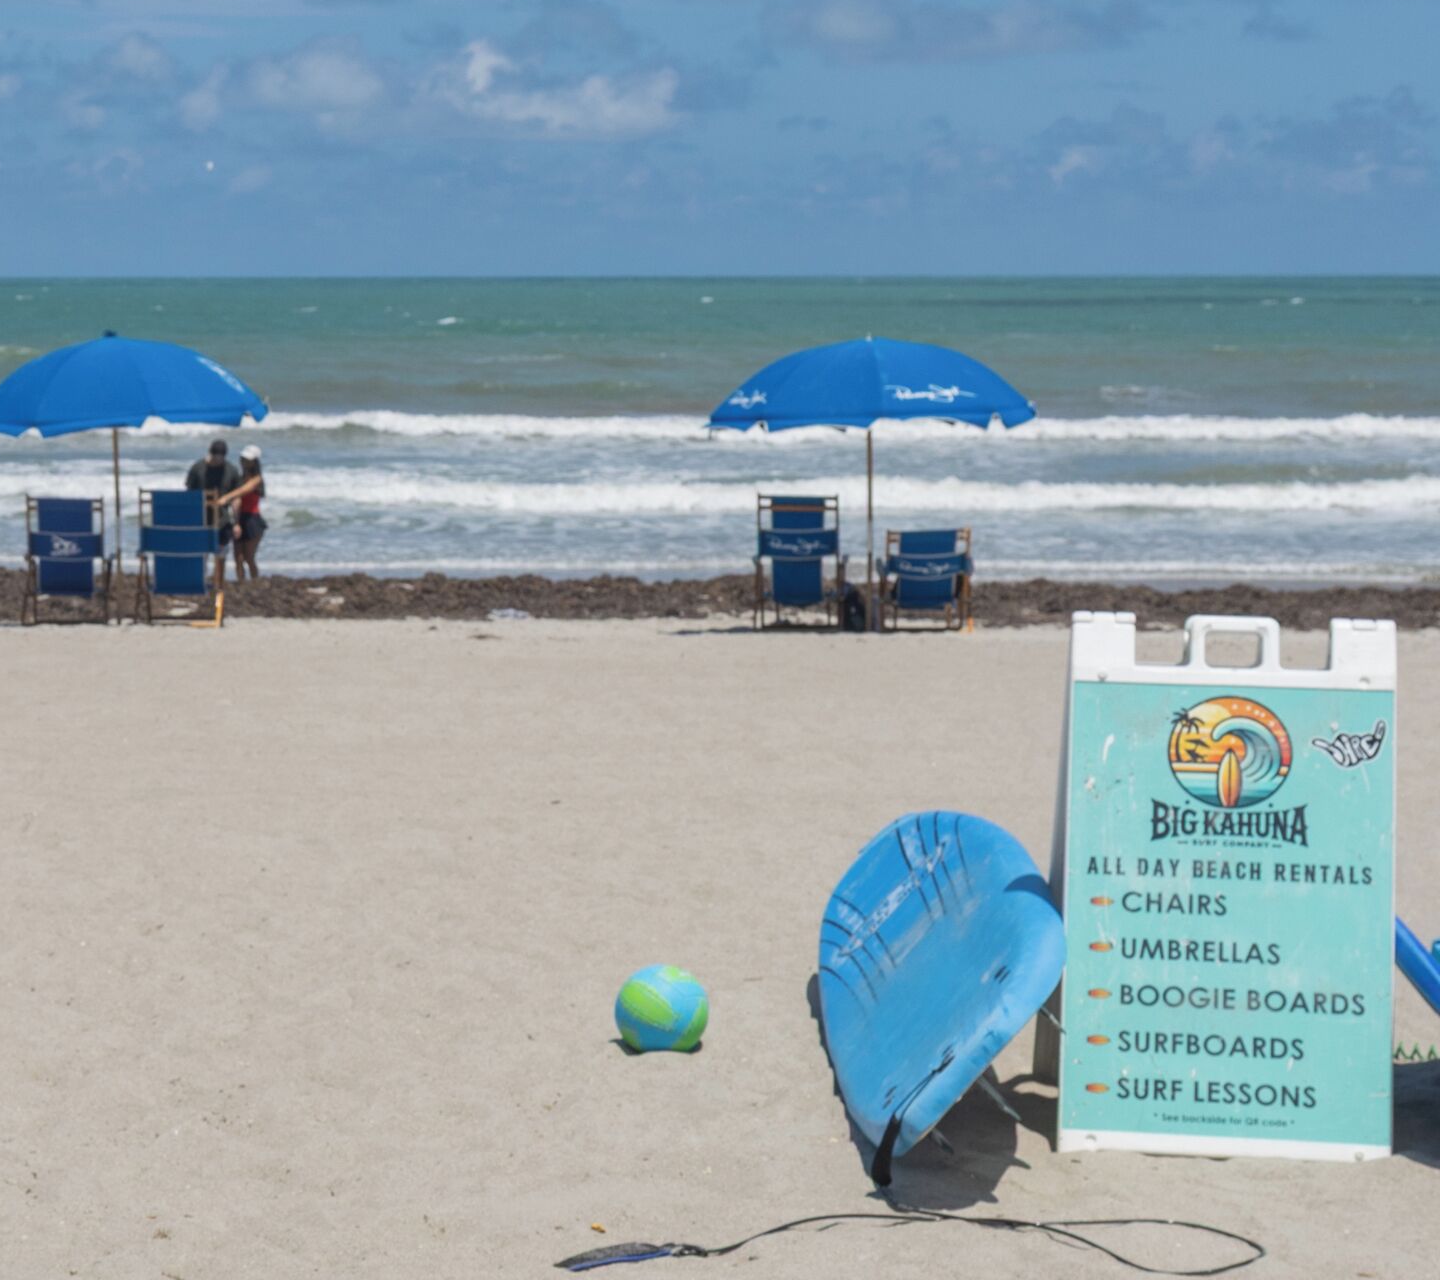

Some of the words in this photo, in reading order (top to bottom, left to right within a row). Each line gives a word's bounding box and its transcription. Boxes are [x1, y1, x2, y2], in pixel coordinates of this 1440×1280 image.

[1151, 798, 1199, 841] BIG
[1203, 803, 1309, 848] KAHUNA
[1192, 839, 1218, 847] SURF
[1222, 840, 1270, 849] COMPANY
[1087, 857, 1126, 876] ALL
[1138, 858, 1179, 878] DAY
[1192, 861, 1262, 882] BEACH
[1274, 864, 1373, 886] RENTALS
[1121, 891, 1228, 917] CHAIRS
[1121, 938, 1281, 966] UMBRELLAS
[1120, 985, 1236, 1011] BOOGIE
[1247, 989, 1366, 1017] BOARDS
[1118, 1031, 1304, 1061] SURFBOARDS
[1116, 1078, 1183, 1102] SURF
[1194, 1081, 1317, 1109] LESSONS
